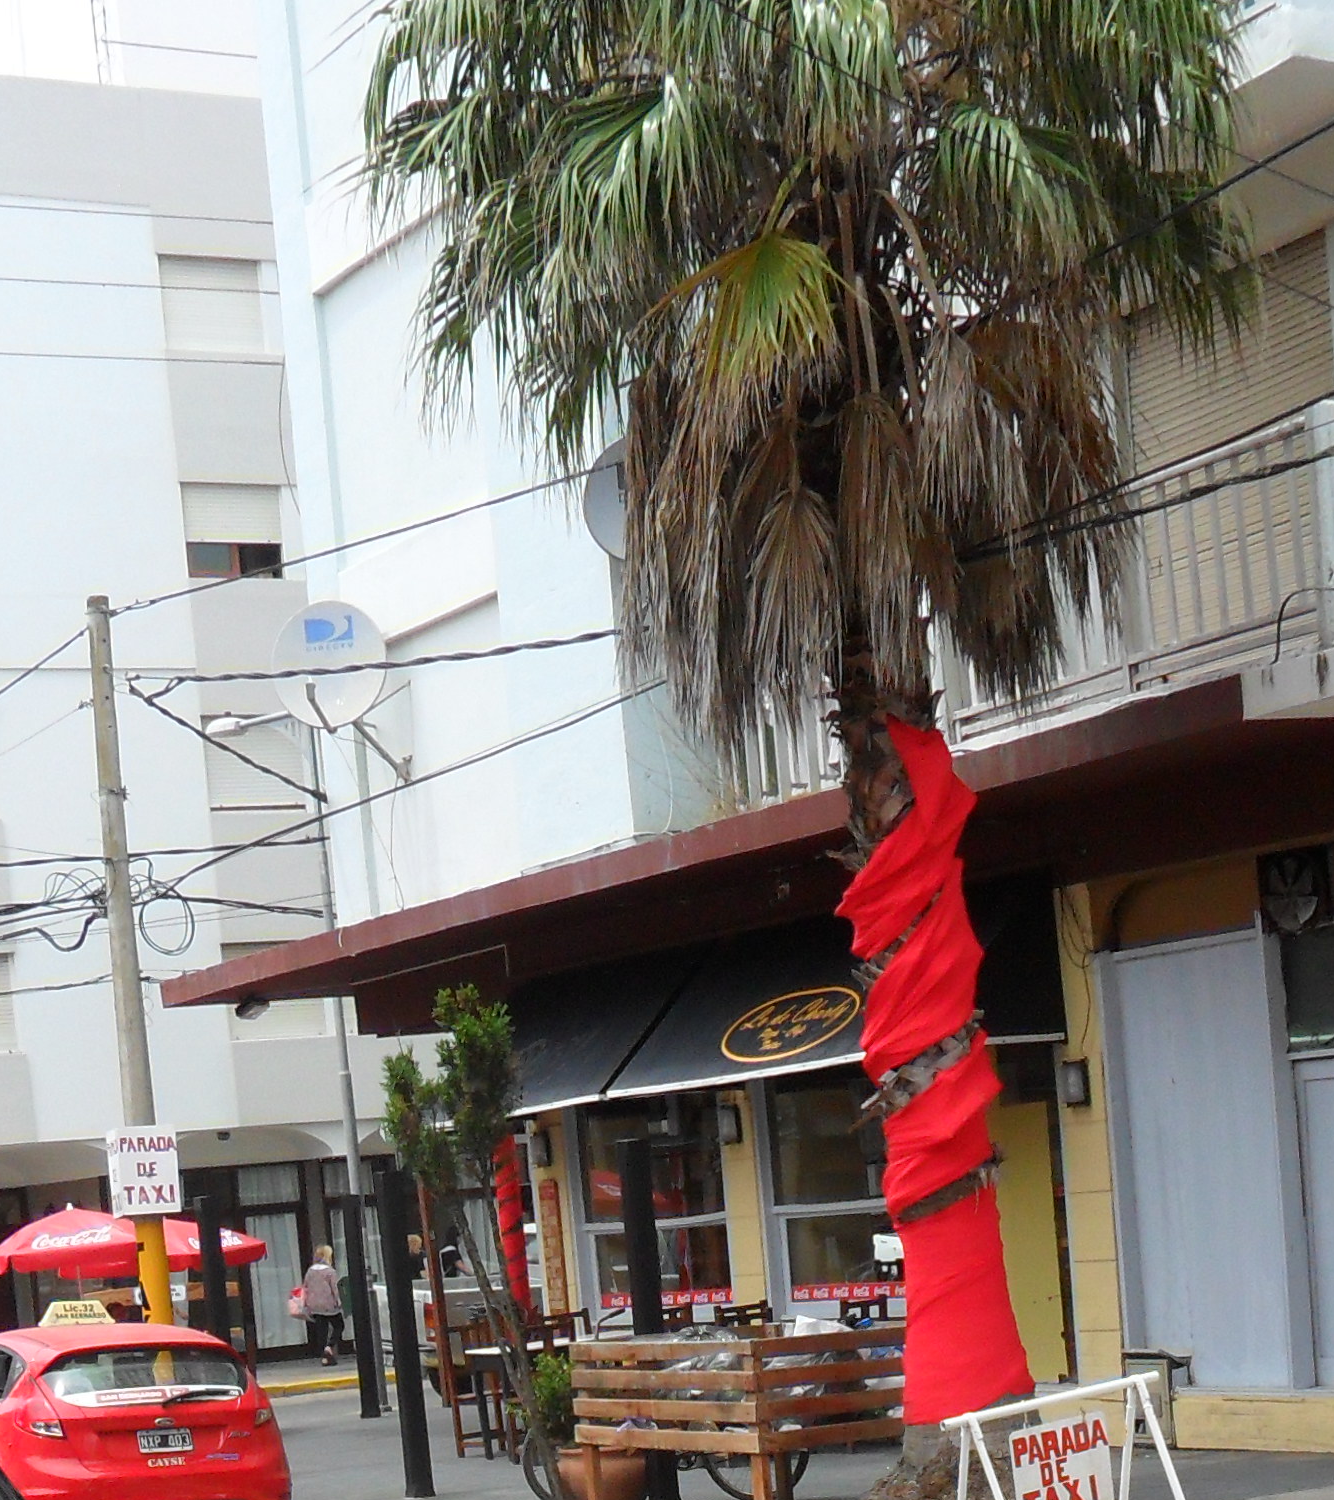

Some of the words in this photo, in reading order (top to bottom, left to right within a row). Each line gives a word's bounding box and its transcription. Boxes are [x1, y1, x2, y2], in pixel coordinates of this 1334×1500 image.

[119, 1135, 177, 1152] PARADA
[136, 1161, 157, 1178] DE
[123, 1184, 176, 1205] TAXI
[31, 1224, 112, 1250] Coca-Cola
[139, 1435, 162, 1450] NXP
[167, 1433, 191, 1448] 403
[1012, 1419, 1109, 1468] PARADA
[147, 1456, 186, 1468] CAYSE
[1039, 1456, 1070, 1488] DE
